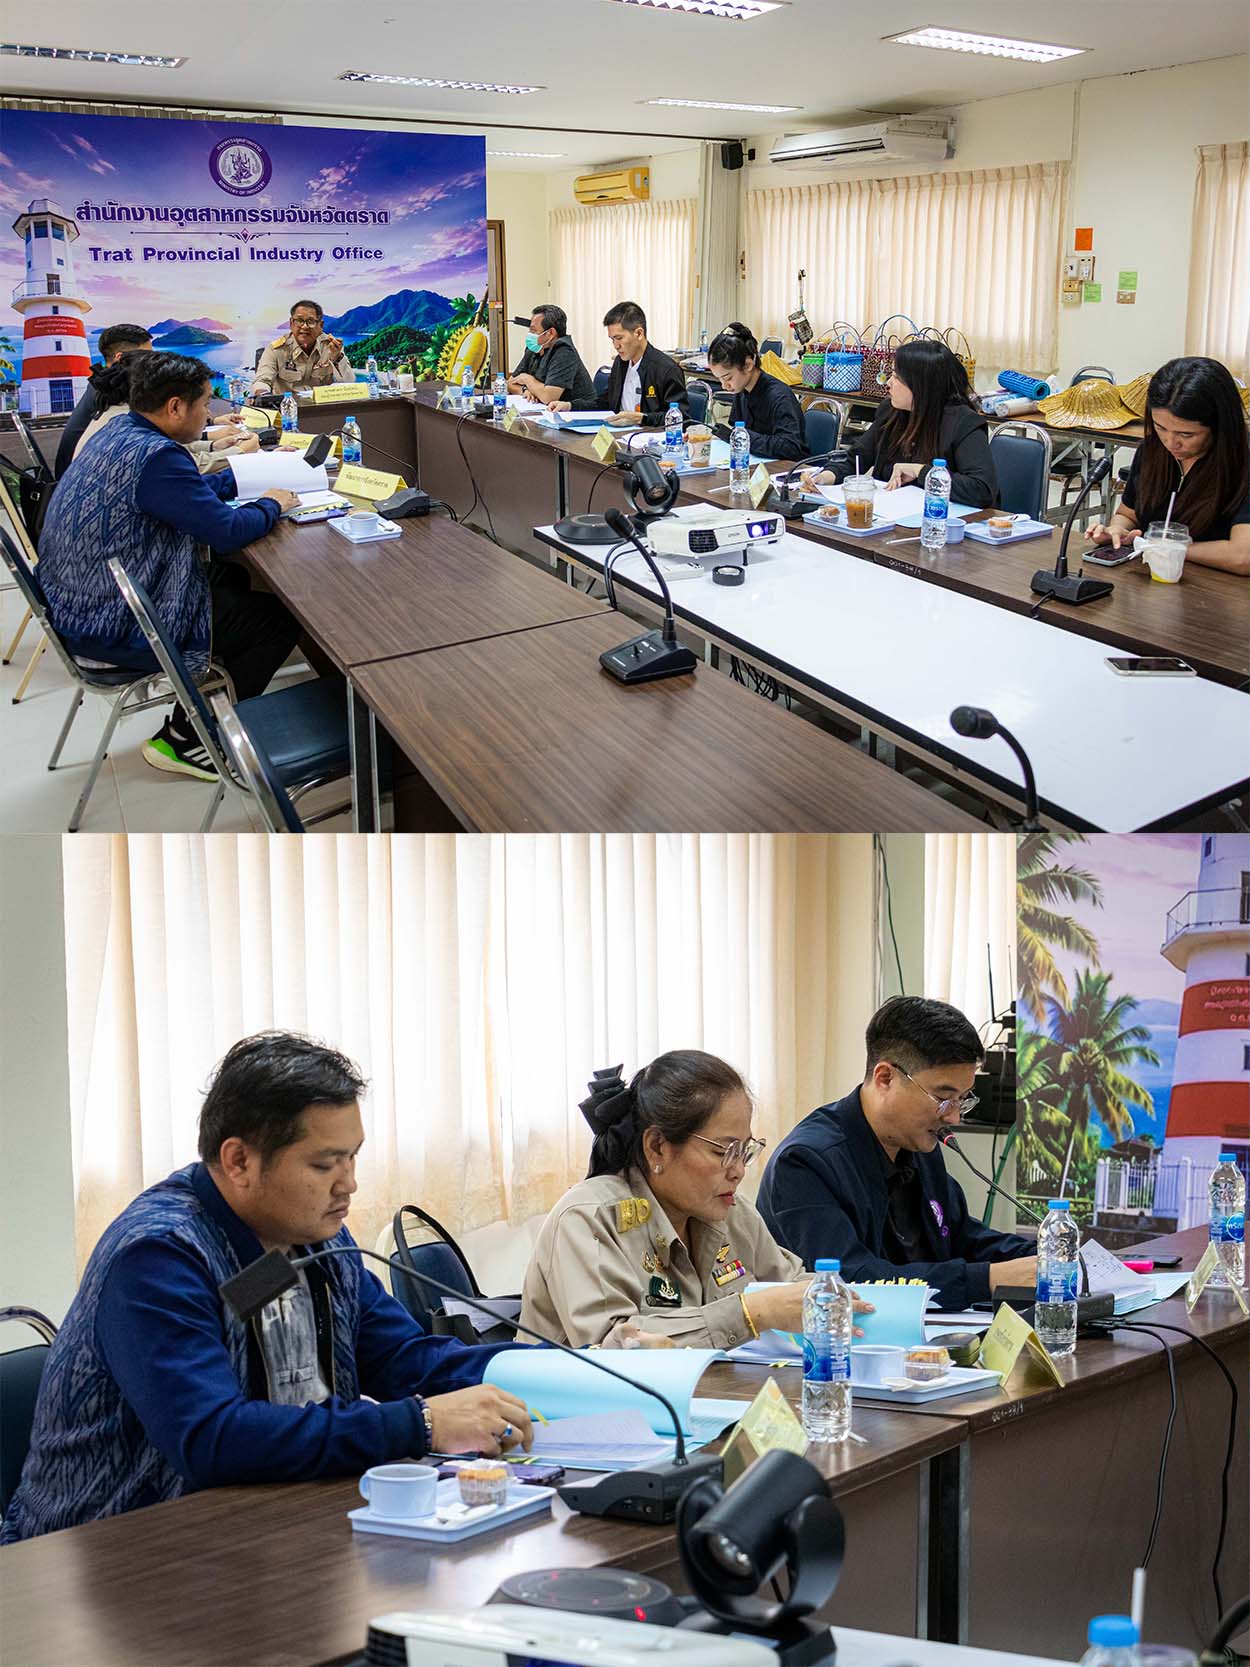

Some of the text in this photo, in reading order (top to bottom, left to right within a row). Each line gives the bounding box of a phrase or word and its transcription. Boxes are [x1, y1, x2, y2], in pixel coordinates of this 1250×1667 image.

[76, 200, 389, 227] สำนักงานอุตสาหกรรมจังหวัดตราด
[89, 246, 384, 263] Trat Provincial Industry Office
